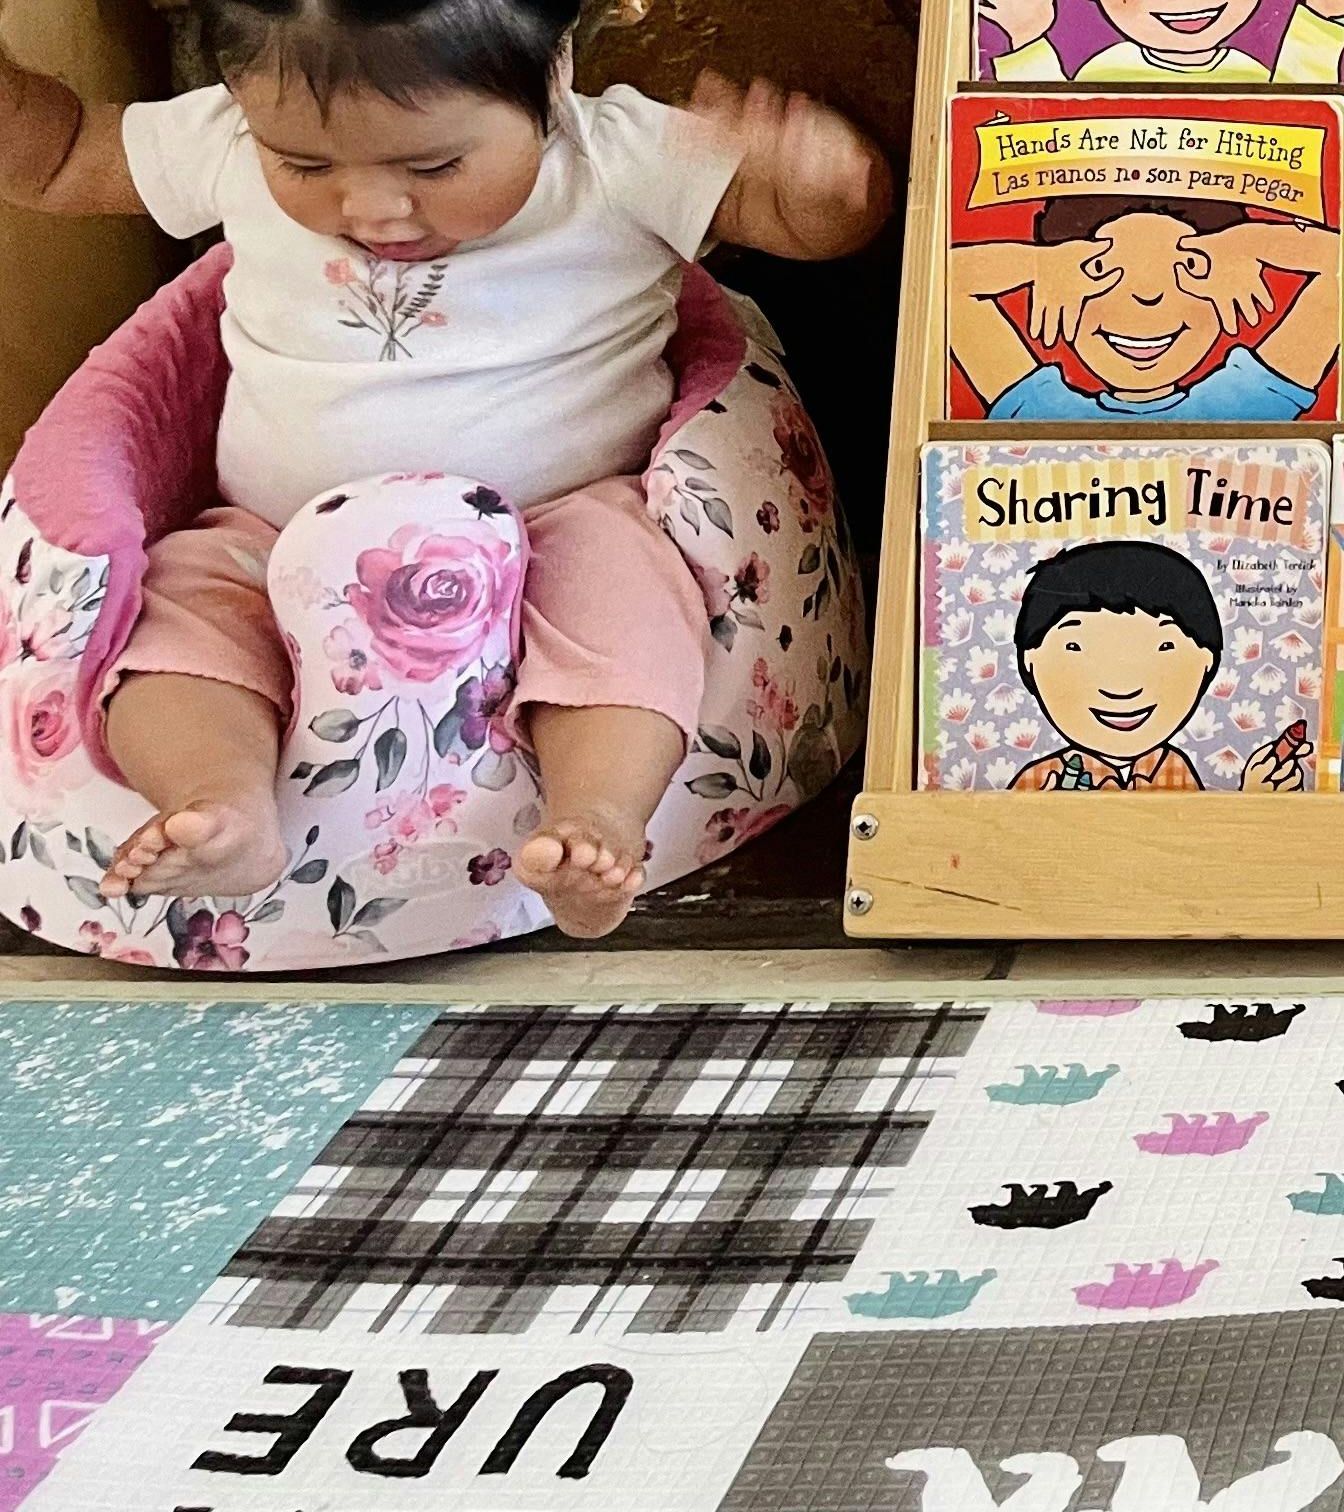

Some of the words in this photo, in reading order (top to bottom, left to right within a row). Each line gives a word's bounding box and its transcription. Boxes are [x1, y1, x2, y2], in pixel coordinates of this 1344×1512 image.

[996, 128, 1072, 161] Hands
[1079, 129, 1119, 151] Are
[1131, 127, 1168, 151] Not
[1178, 128, 1208, 151] for
[1215, 130, 1304, 168] Hitting
[977, 478, 1167, 527] Sharing
[1186, 468, 1293, 525] Time
